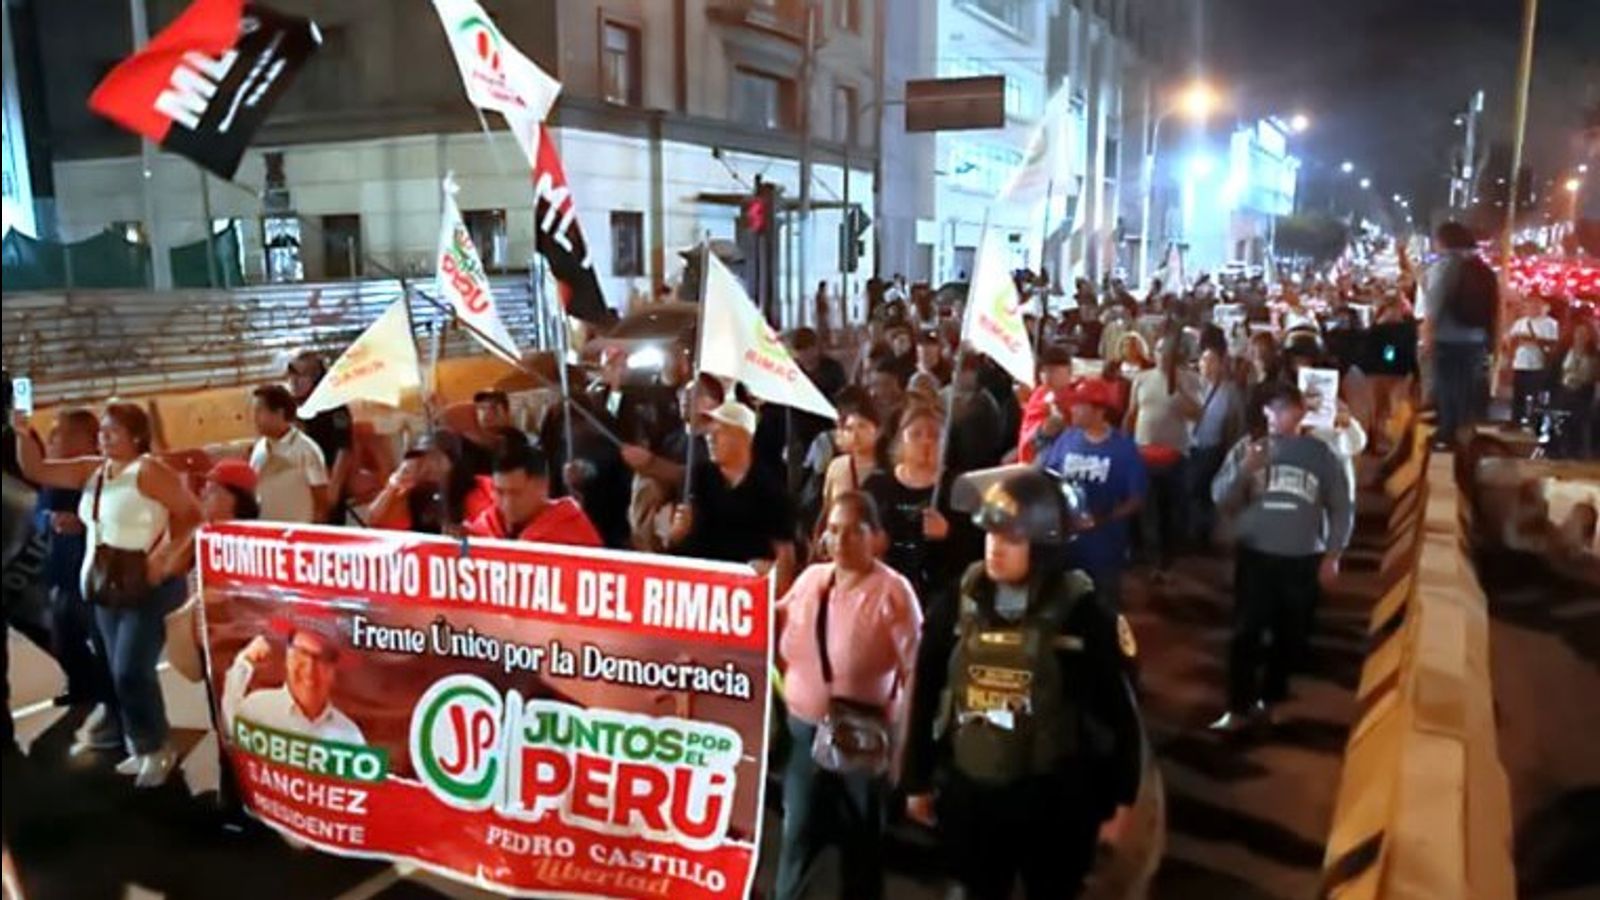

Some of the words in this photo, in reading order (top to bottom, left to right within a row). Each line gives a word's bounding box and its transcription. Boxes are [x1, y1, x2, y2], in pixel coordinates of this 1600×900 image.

[153, 50, 239, 131] ML
[294, 541, 420, 598] EJECUTIVO
[428, 554, 567, 615] DISTRITAL
[576, 569, 633, 623] DEL
[641, 576, 754, 638] RIMAC
[352, 615, 426, 654] Frente
[430, 614, 500, 662] Único
[503, 641, 545, 675] por
[551, 641, 575, 676] la
[583, 646, 751, 699] Democracia
[235, 722, 382, 781] ROBERTO
[524, 711, 684, 763] JUNTOS
[687, 731, 732, 752] POR
[685, 751, 708, 767] EL
[520, 746, 727, 840] PERÚ
[486, 825, 576, 858] PEDRO
[589, 844, 727, 893] CASTILLO
